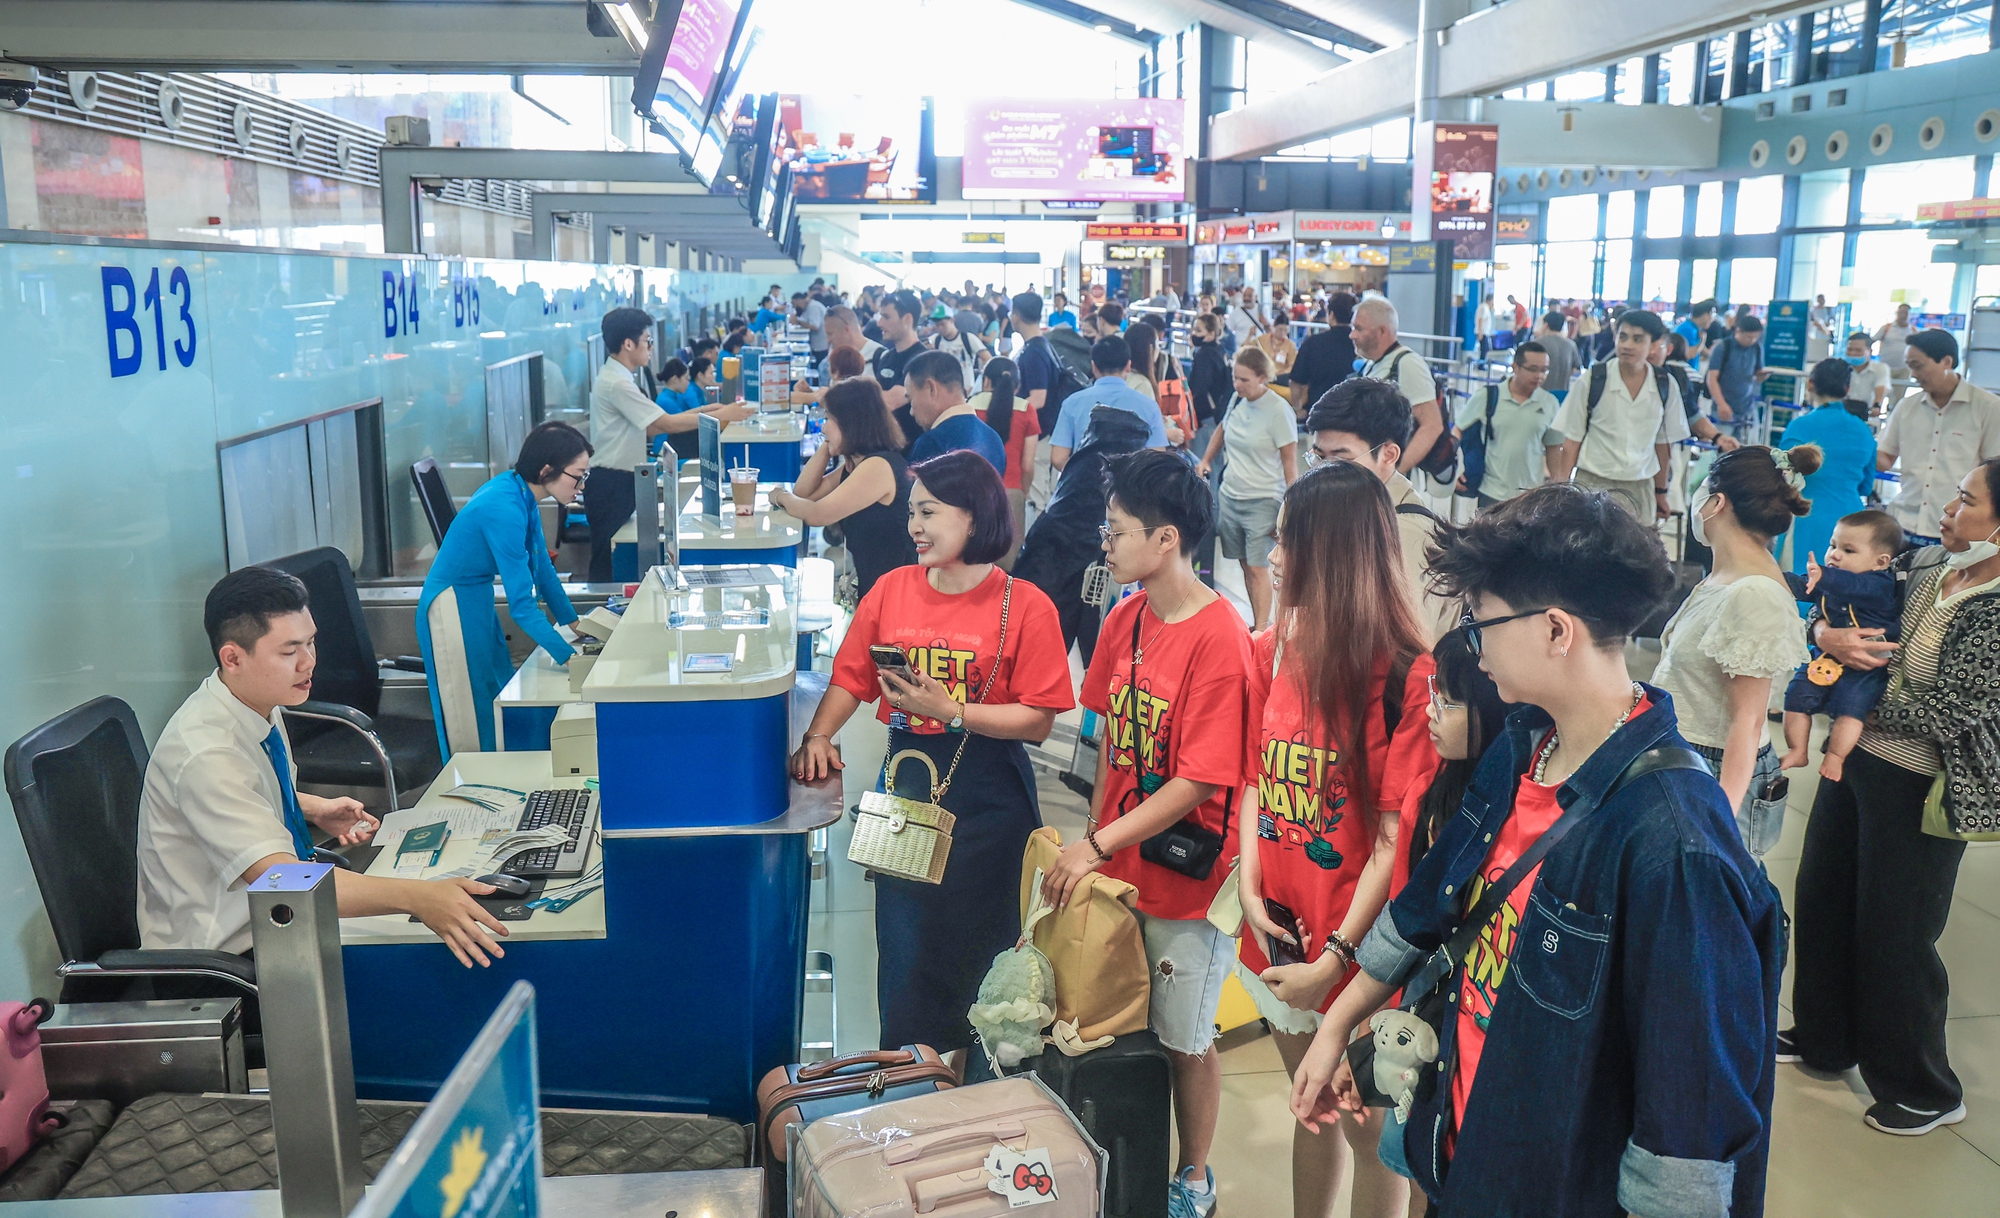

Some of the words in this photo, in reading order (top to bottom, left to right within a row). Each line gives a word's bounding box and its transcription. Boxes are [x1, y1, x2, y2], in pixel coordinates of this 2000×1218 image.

[101, 265, 197, 378] B13
[382, 270, 420, 339] B14
[453, 271, 480, 328] B15
[703, 477, 717, 492] CLOSED
[1259, 738, 1339, 790] VIET
[1257, 770, 1322, 834] NAM
[1541, 929, 1560, 954] S
